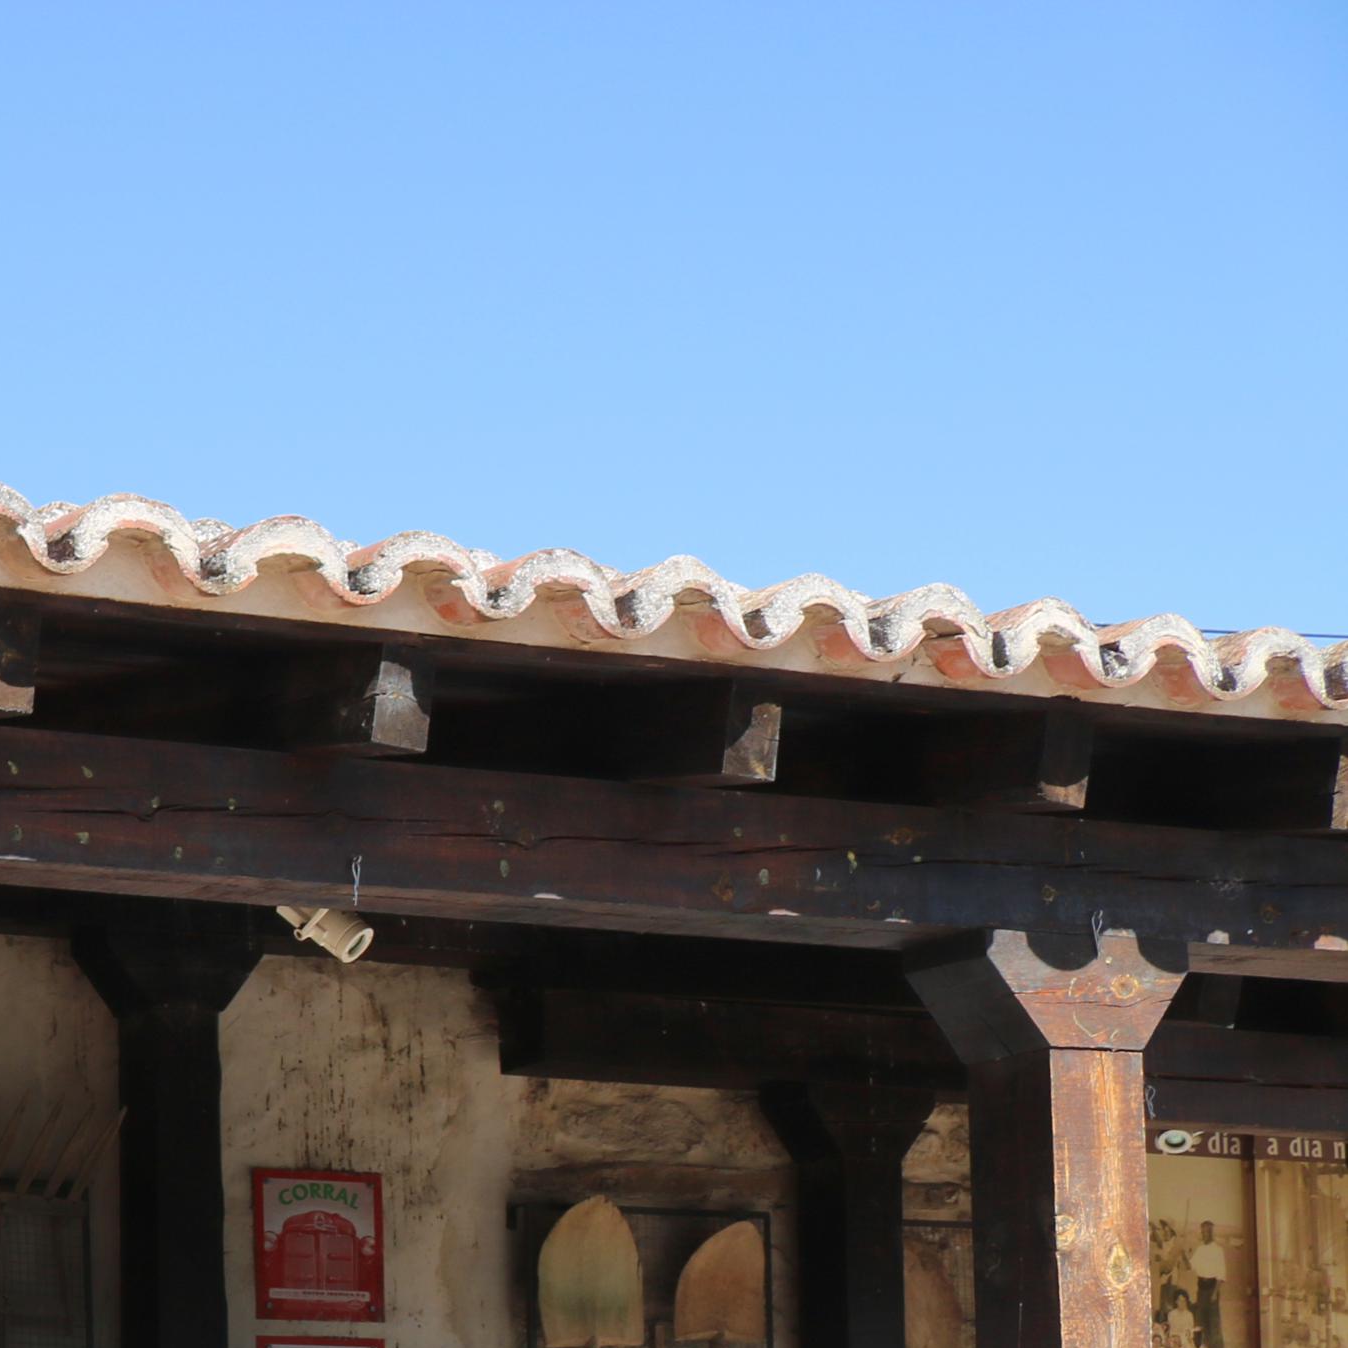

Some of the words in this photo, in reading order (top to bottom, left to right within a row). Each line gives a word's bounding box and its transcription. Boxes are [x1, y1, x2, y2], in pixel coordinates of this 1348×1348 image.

[1208, 1132, 1241, 1155] día
[1267, 1137, 1279, 1155] a
[278, 1182, 359, 1210] CORRAL
